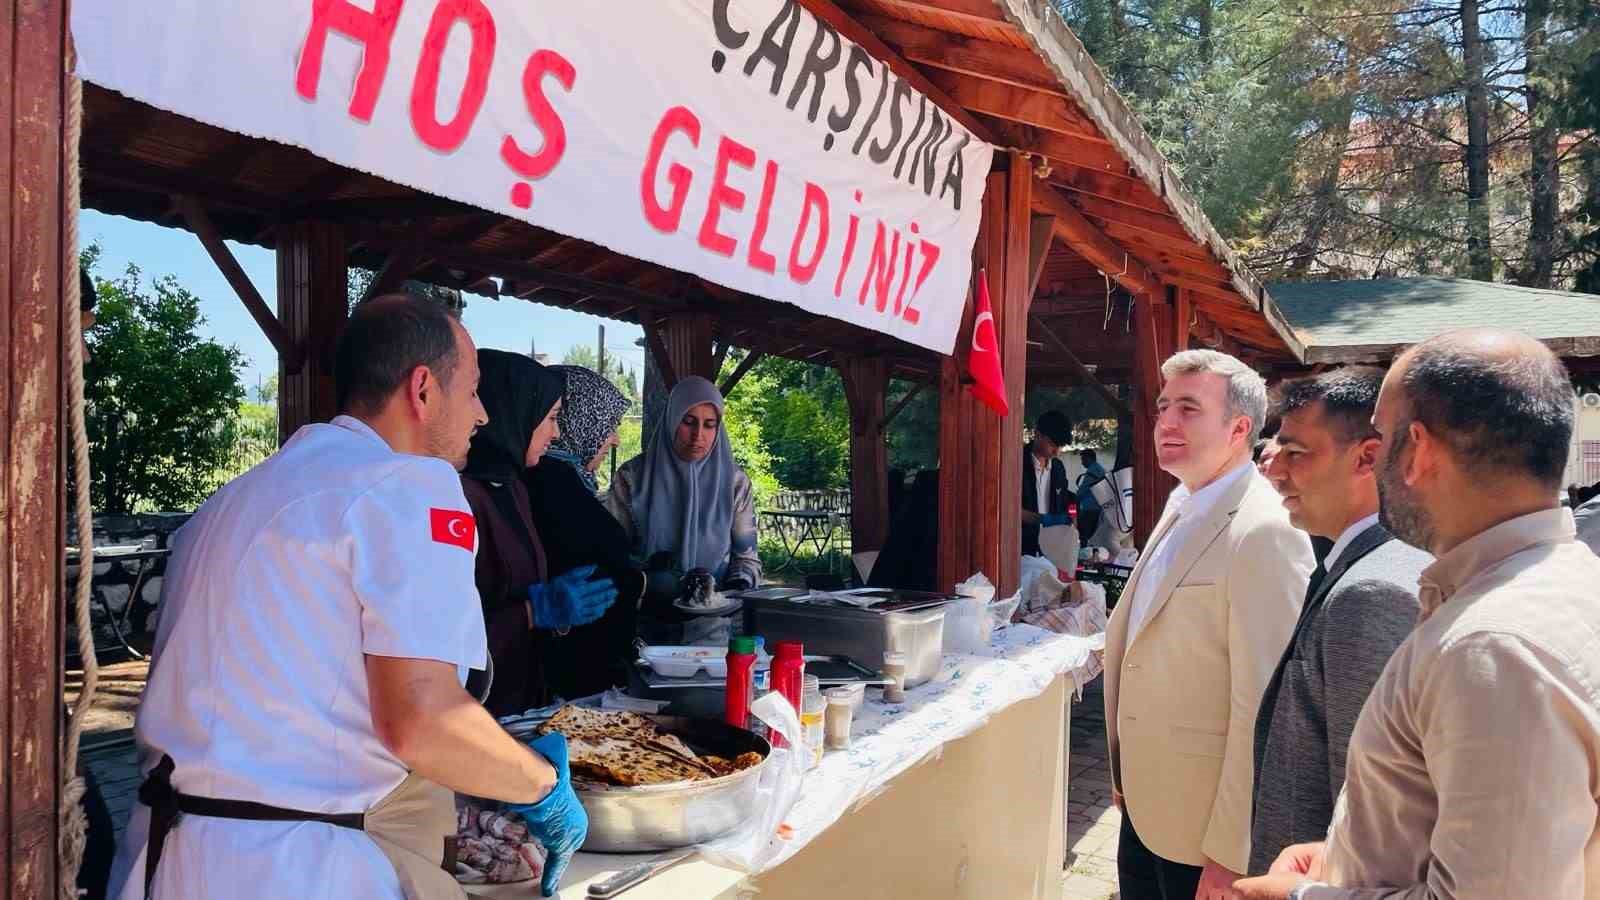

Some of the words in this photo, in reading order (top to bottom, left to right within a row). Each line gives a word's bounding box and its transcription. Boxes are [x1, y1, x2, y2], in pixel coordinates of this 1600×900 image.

[295, 0, 577, 209] HOŞ
[640, 105, 941, 326] GELDİNİZ
[711, 0, 970, 210] ÇARŞISINA
